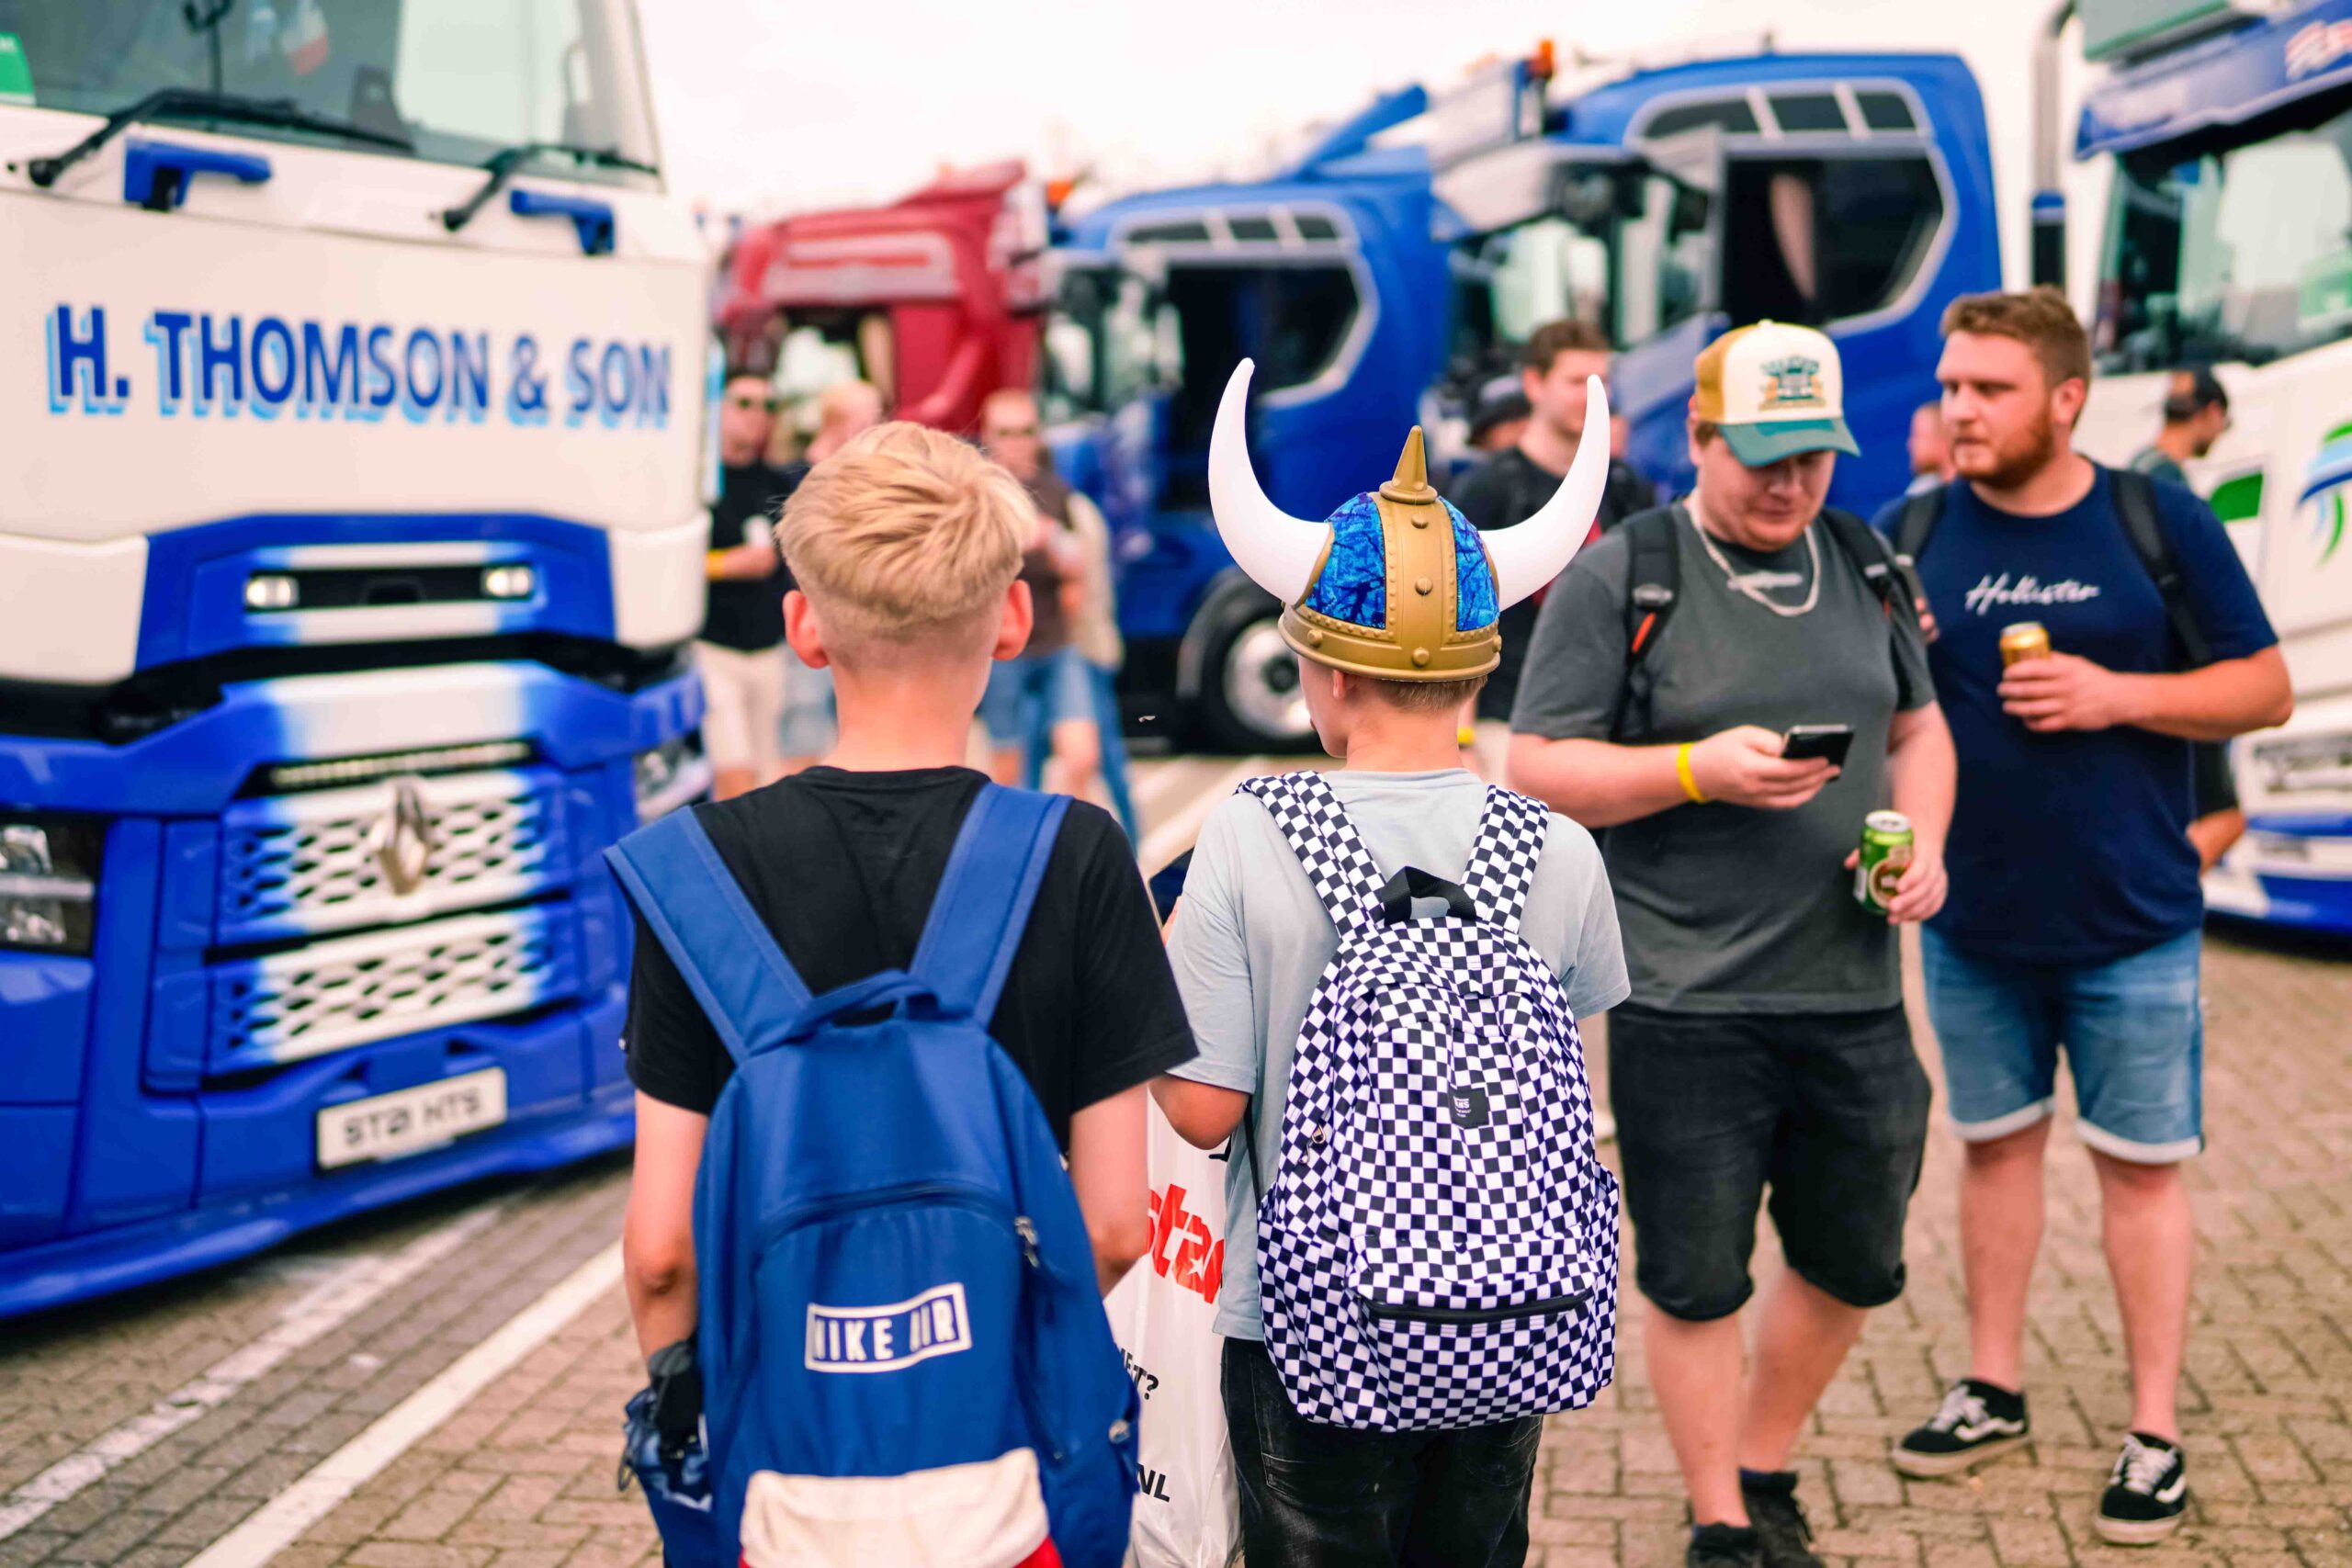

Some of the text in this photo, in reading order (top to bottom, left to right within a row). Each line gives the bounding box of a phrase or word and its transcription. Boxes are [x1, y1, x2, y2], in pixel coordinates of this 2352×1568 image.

[47, 305, 671, 429] H. THOMSON & SON
